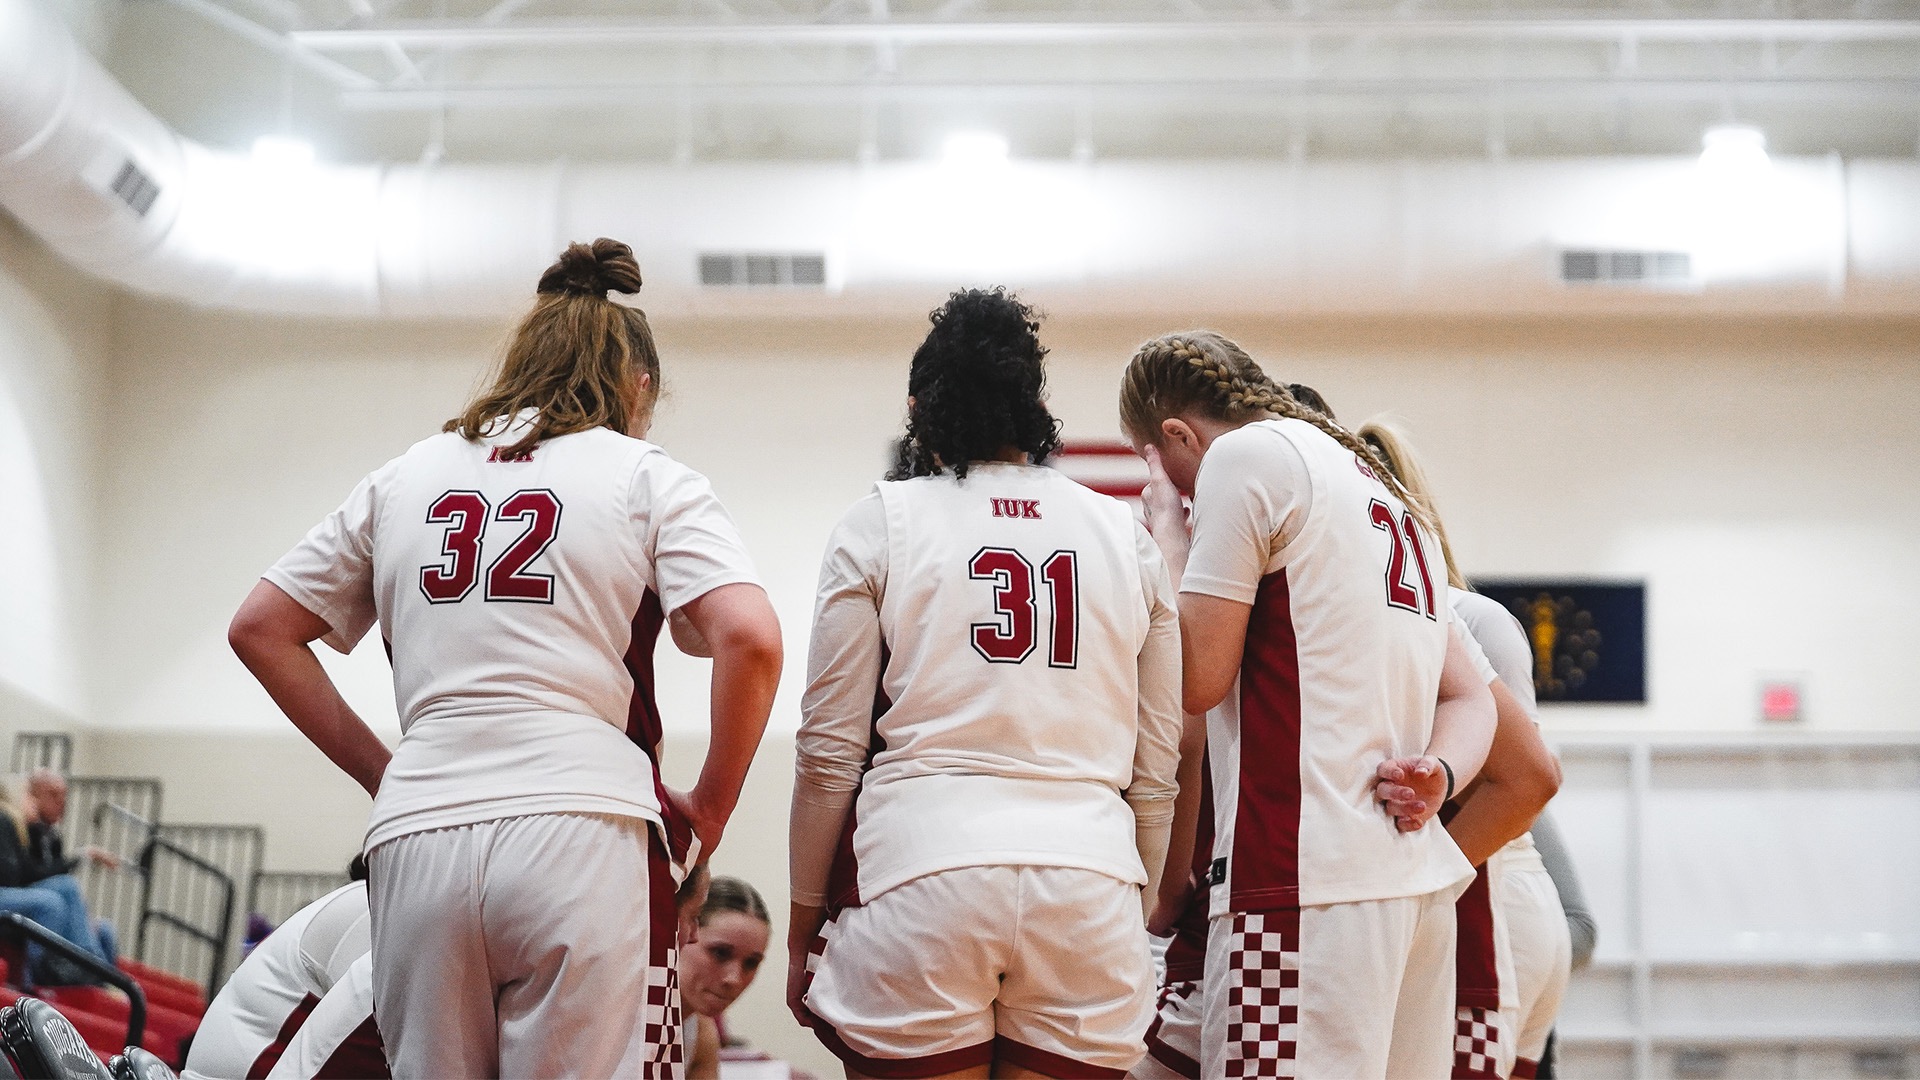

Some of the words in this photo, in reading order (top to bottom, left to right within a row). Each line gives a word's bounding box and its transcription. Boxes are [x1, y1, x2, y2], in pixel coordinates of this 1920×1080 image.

[419, 488, 563, 605] 32
[990, 497, 1042, 519] IUK
[1367, 497, 1437, 622] 21
[968, 546, 1079, 669] 31
[42, 1018, 98, 1069] COUGARS
